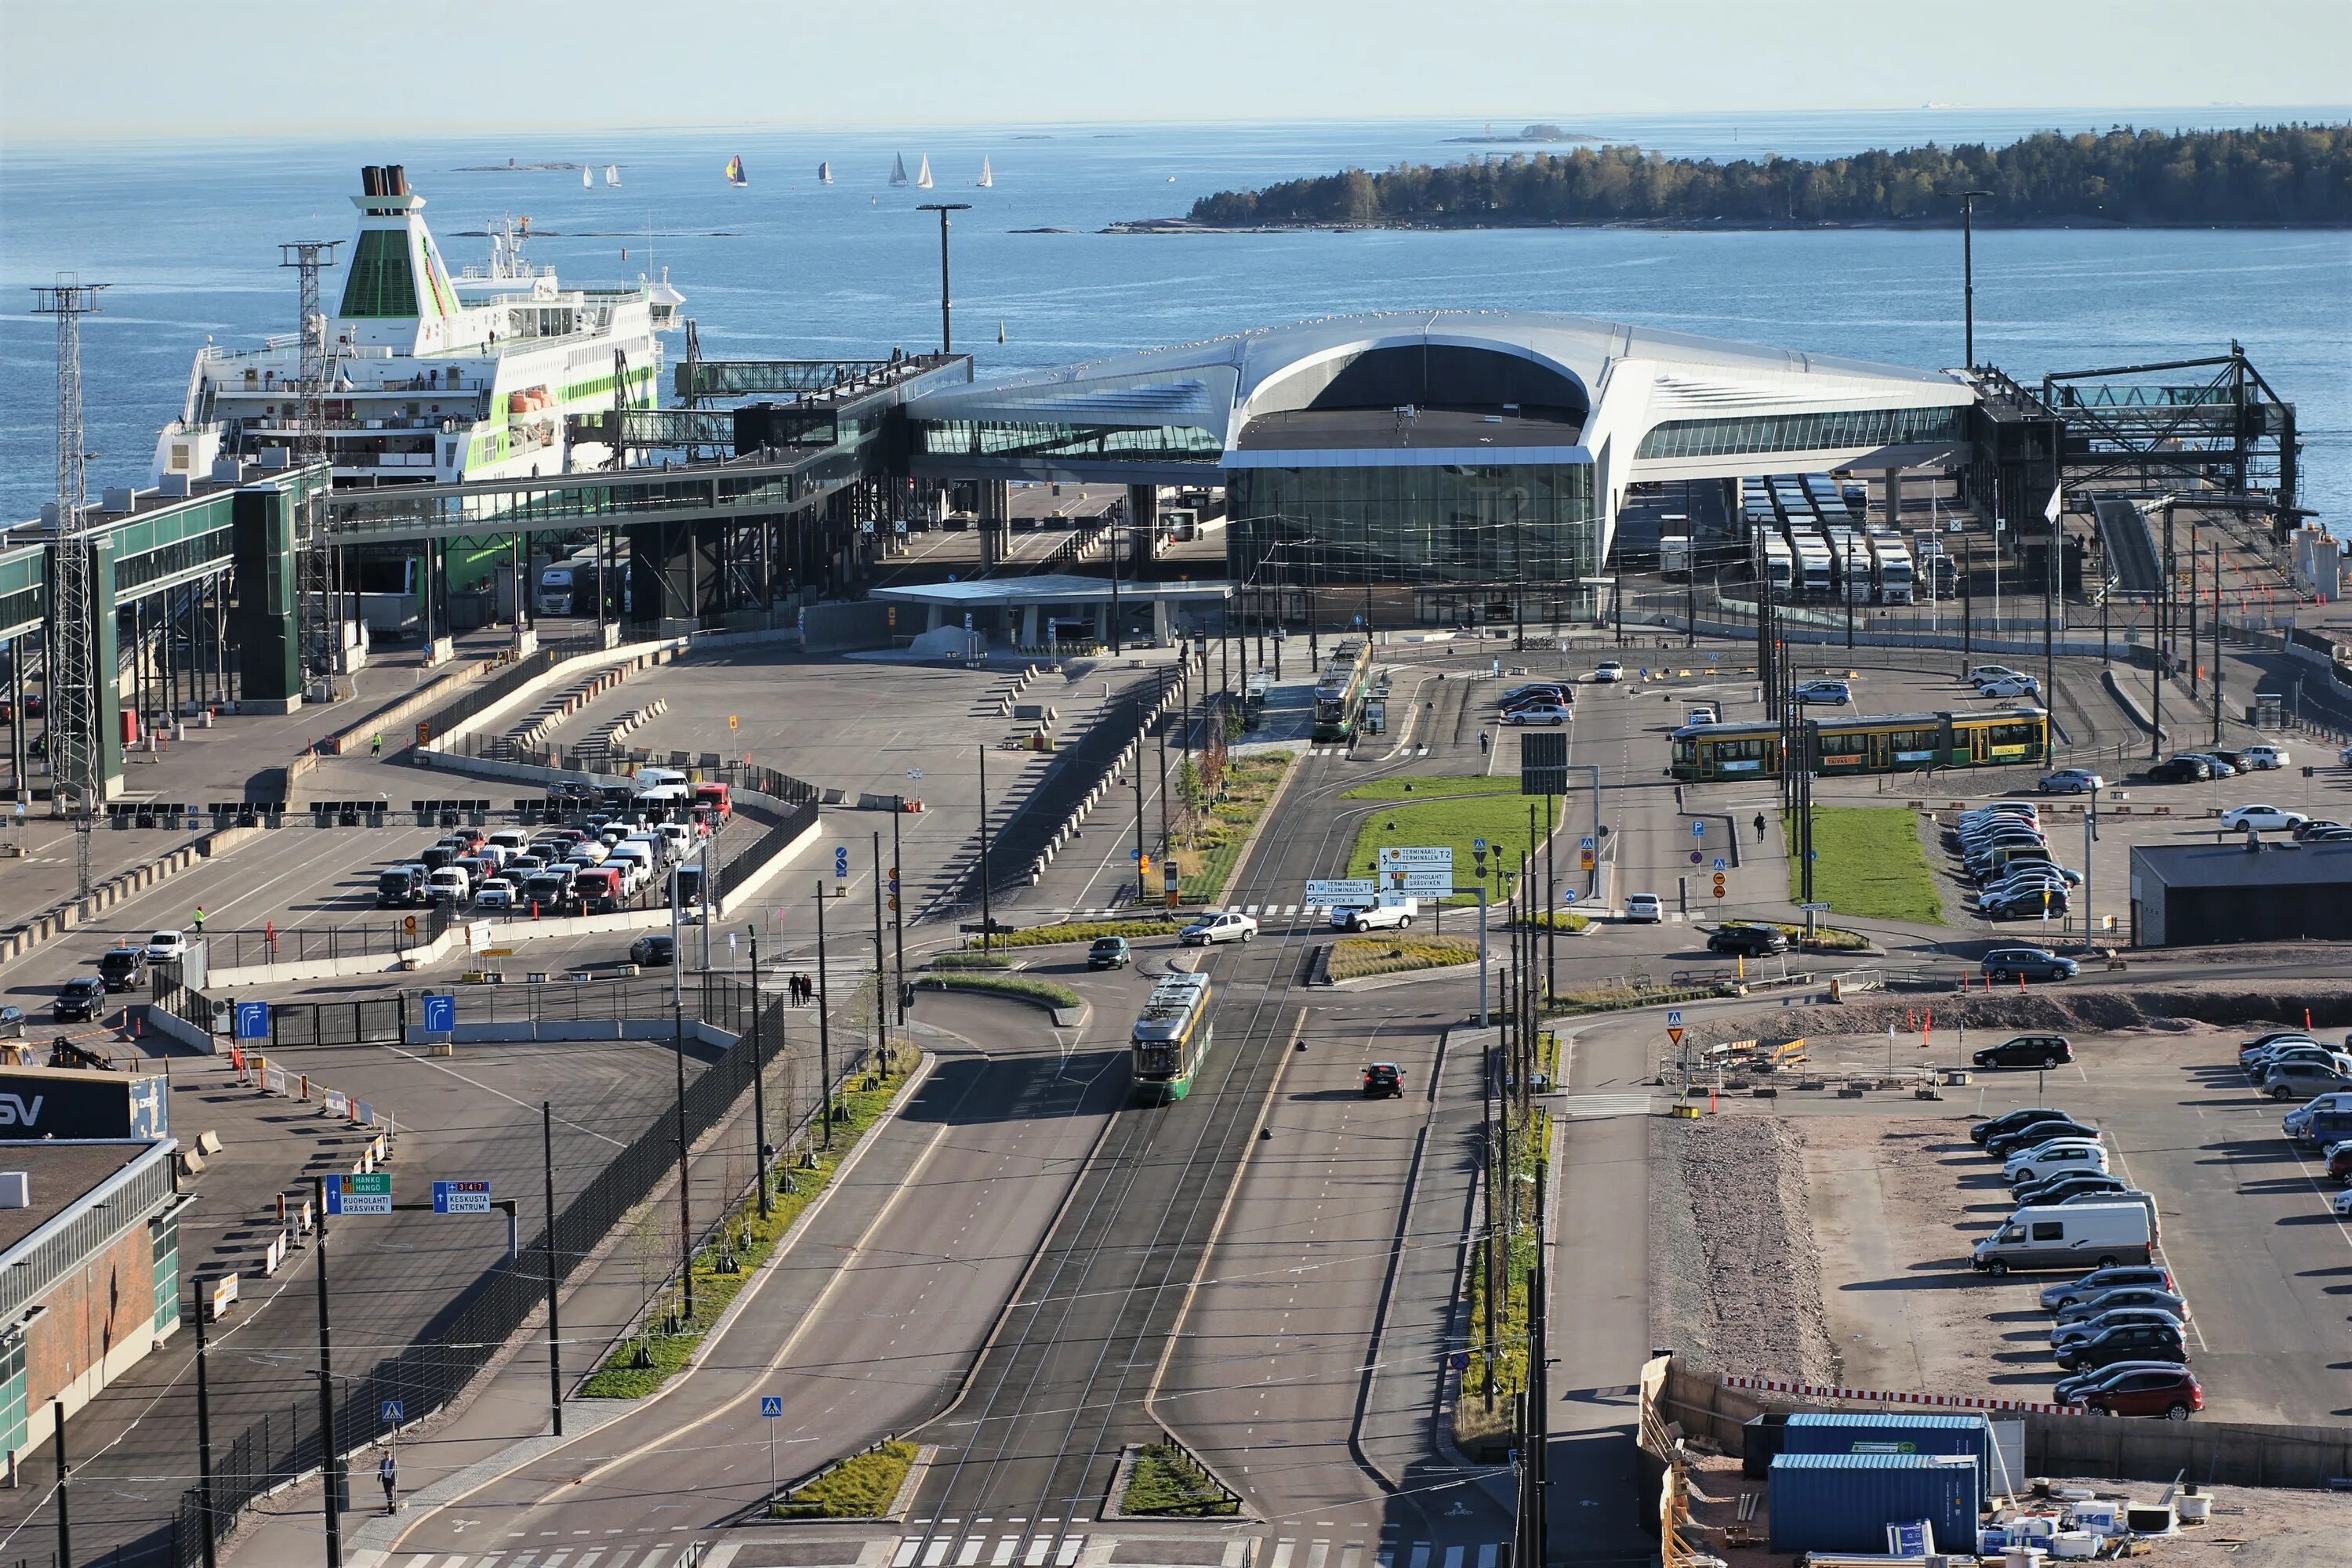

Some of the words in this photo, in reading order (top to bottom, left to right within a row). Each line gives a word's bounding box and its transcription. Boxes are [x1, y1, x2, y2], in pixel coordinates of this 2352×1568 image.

[1470, 486, 1529, 524] T2
[355, 1183, 381, 1192] HANGÖ
[343, 1203, 386, 1212] GRÄSVIKEN
